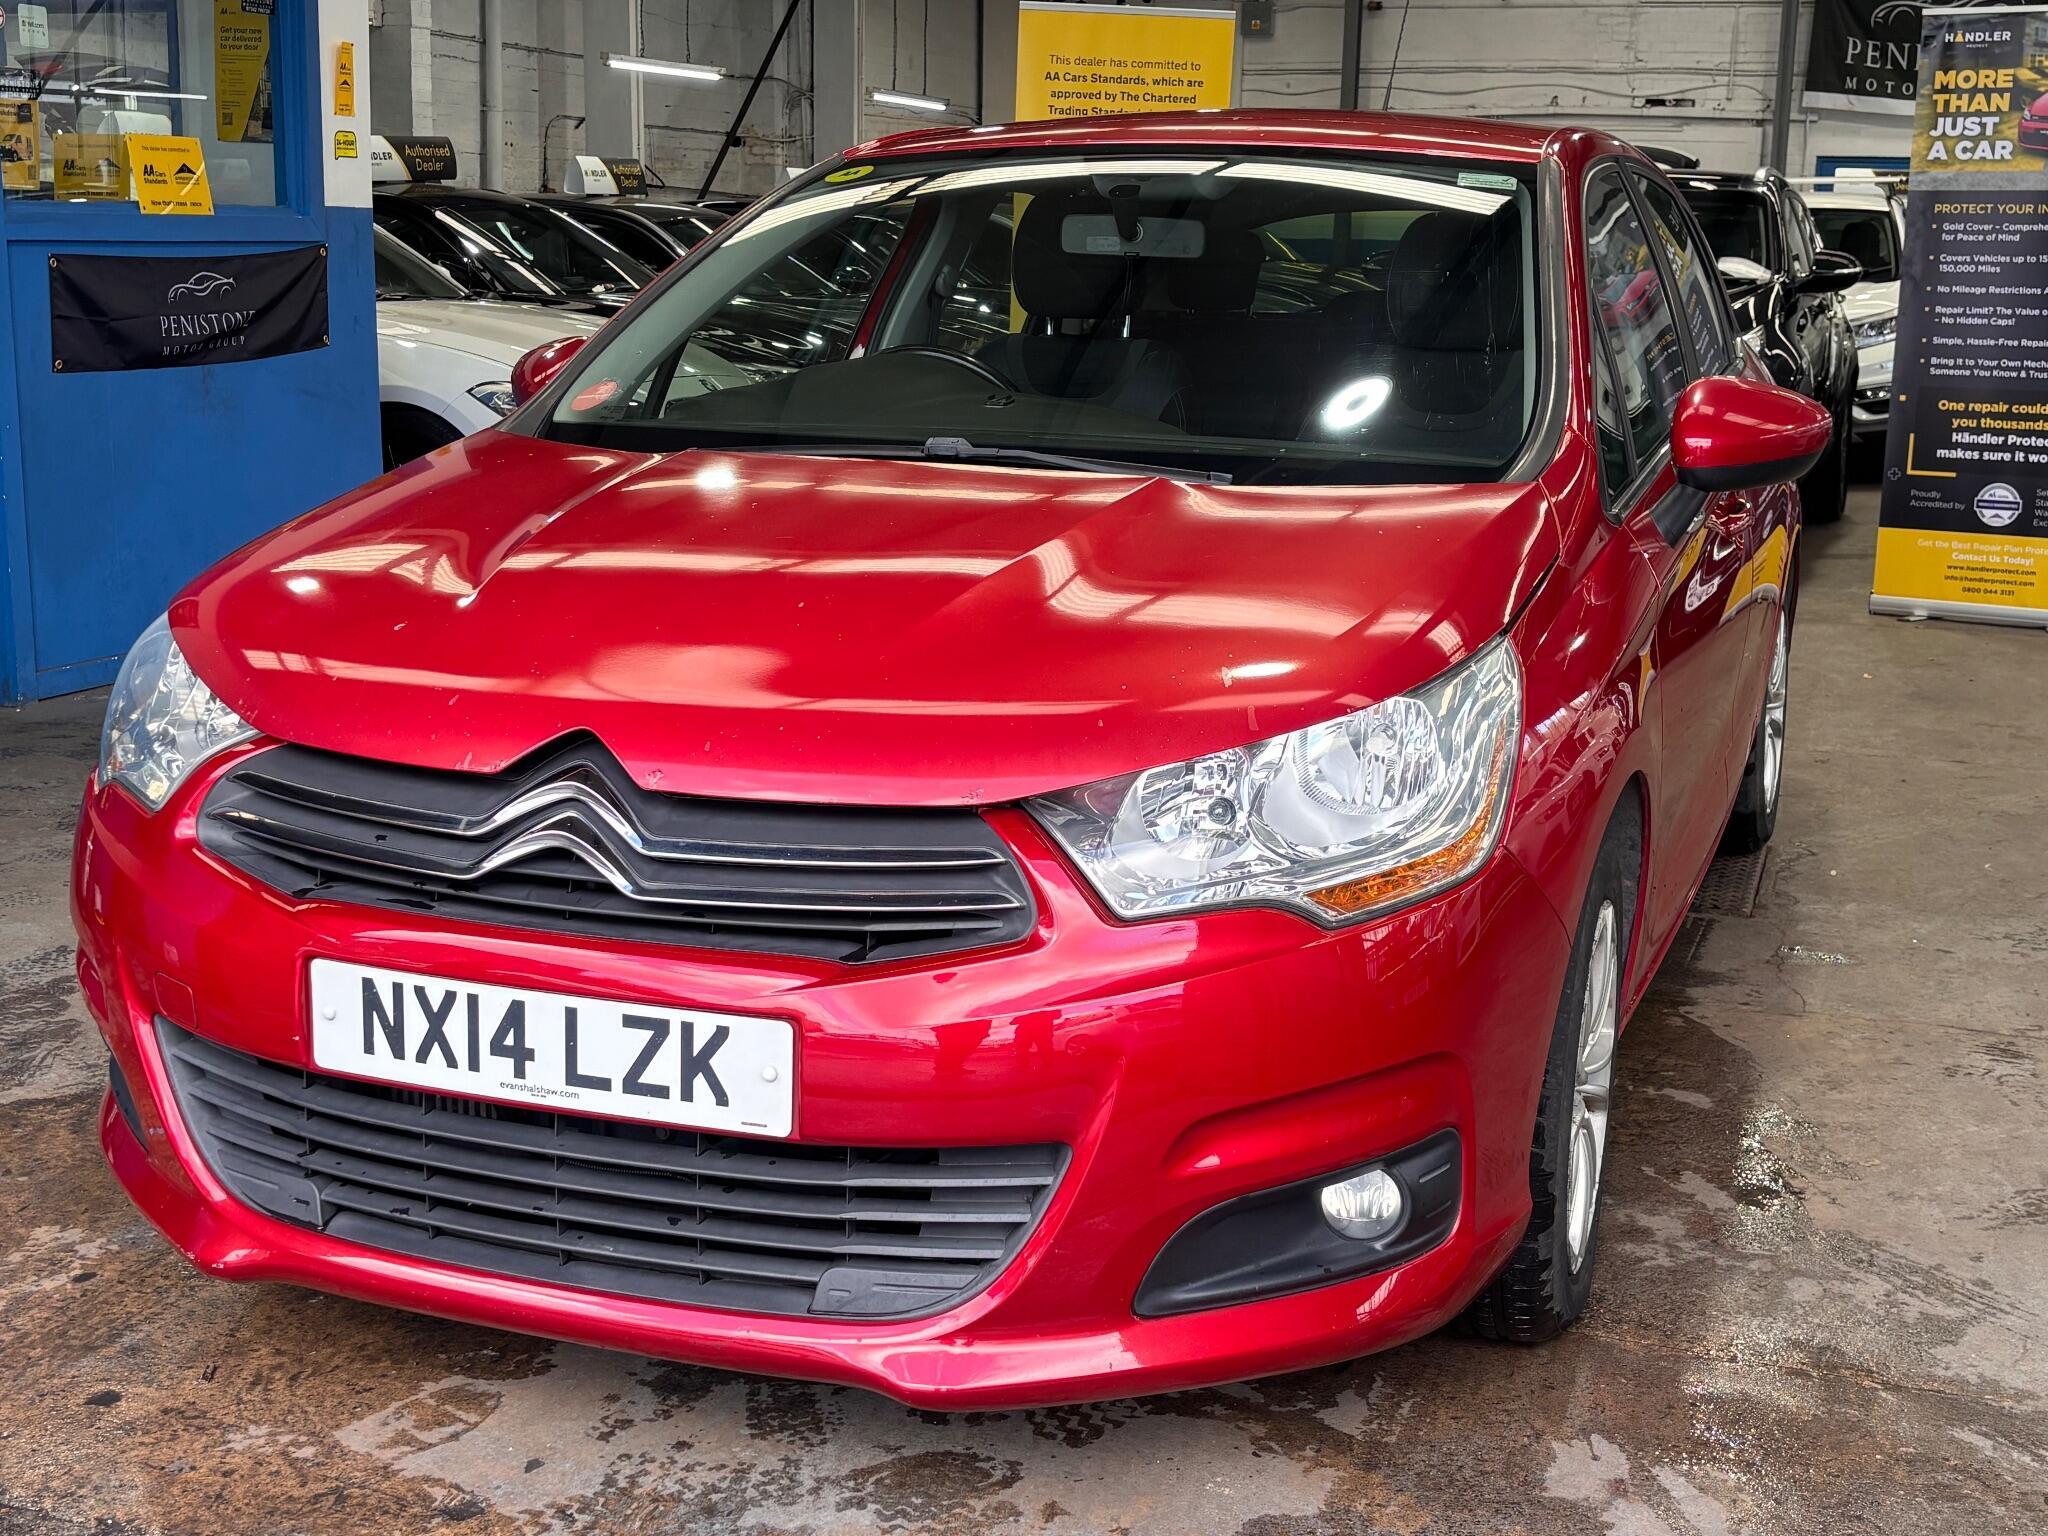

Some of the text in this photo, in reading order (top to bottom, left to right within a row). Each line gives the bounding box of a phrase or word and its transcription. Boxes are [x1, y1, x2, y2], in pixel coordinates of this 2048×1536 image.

[220, 26, 232, 34] Get
[232, 34, 262, 42] delivered
[220, 42, 228, 50] to
[1050, 54, 1202, 72] This dealer has committed to
[1044, 72, 1204, 88] AA Cars Standards, which are
[1934, 68, 2014, 90] MORE
[1050, 88, 1196, 104] approved by The Chartered
[1932, 92, 2011, 113] THAN
[1048, 105, 1088, 116] Trading
[1929, 116, 2000, 136] JUST
[404, 144, 450, 158] Authorised
[1926, 140, 2014, 160] A CAR
[371, 152, 393, 161] DLER
[144, 164, 166, 178] AA Cars
[416, 158, 444, 172] Dealer
[613, 164, 642, 176] Authorised
[620, 176, 638, 188] Dealer
[1934, 204, 1994, 214] PROTECT
[1997, 204, 2034, 214] YOUR
[1942, 222, 1964, 231] Gold
[1966, 222, 1994, 231] Cover
[1957, 233, 1984, 241] Peace
[1986, 233, 1996, 241] of
[1940, 254, 1970, 262] Covers
[1973, 254, 2010, 262] Vehicles
[2012, 256, 2024, 264] up
[2026, 255, 2036, 263] to
[1938, 264, 2000, 273] 150,000 Miles
[1952, 286, 1986, 295] Mileage
[1988, 286, 2042, 294] Restrictions
[1935, 306, 1964, 314] Repair
[1966, 306, 1994, 315] Limit?
[1996, 307, 2012, 315] The
[2015, 307, 2040, 316] Value
[1956, 317, 1988, 325] Hidden
[1990, 318, 2016, 326] Caps!
[1932, 337, 1965, 346] Simple,
[1967, 338, 2019, 347] Hassle-Free
[1930, 357, 1954, 366] Bring
[1956, 358, 1963, 366] It
[1965, 358, 1975, 366] to
[2000, 359, 2021, 367] Own
[1930, 367, 1971, 376] Someone
[1973, 368, 1990, 377] You
[1992, 369, 2018, 378] Know
[2020, 370, 2026, 378] &
[1938, 400, 2048, 414] One repair could
[1951, 418, 2048, 431] you thousands
[1952, 432, 2005, 444] Händler
[1936, 448, 1980, 460] makes
[1982, 451, 2012, 461] sure
[2014, 450, 2026, 462] it
[1910, 489, 1941, 499] Proudly
[1909, 499, 1966, 511] Accredited by
[1918, 540, 1932, 548] Get
[1935, 540, 1949, 548] the
[1952, 541, 1970, 550] Best
[2004, 544, 2023, 553] Plan
[1952, 552, 2034, 566] Contact Us Today!
[361, 976, 730, 1108] NX14 LZK
[499, 1080, 580, 1100] evanshalshaw.com
